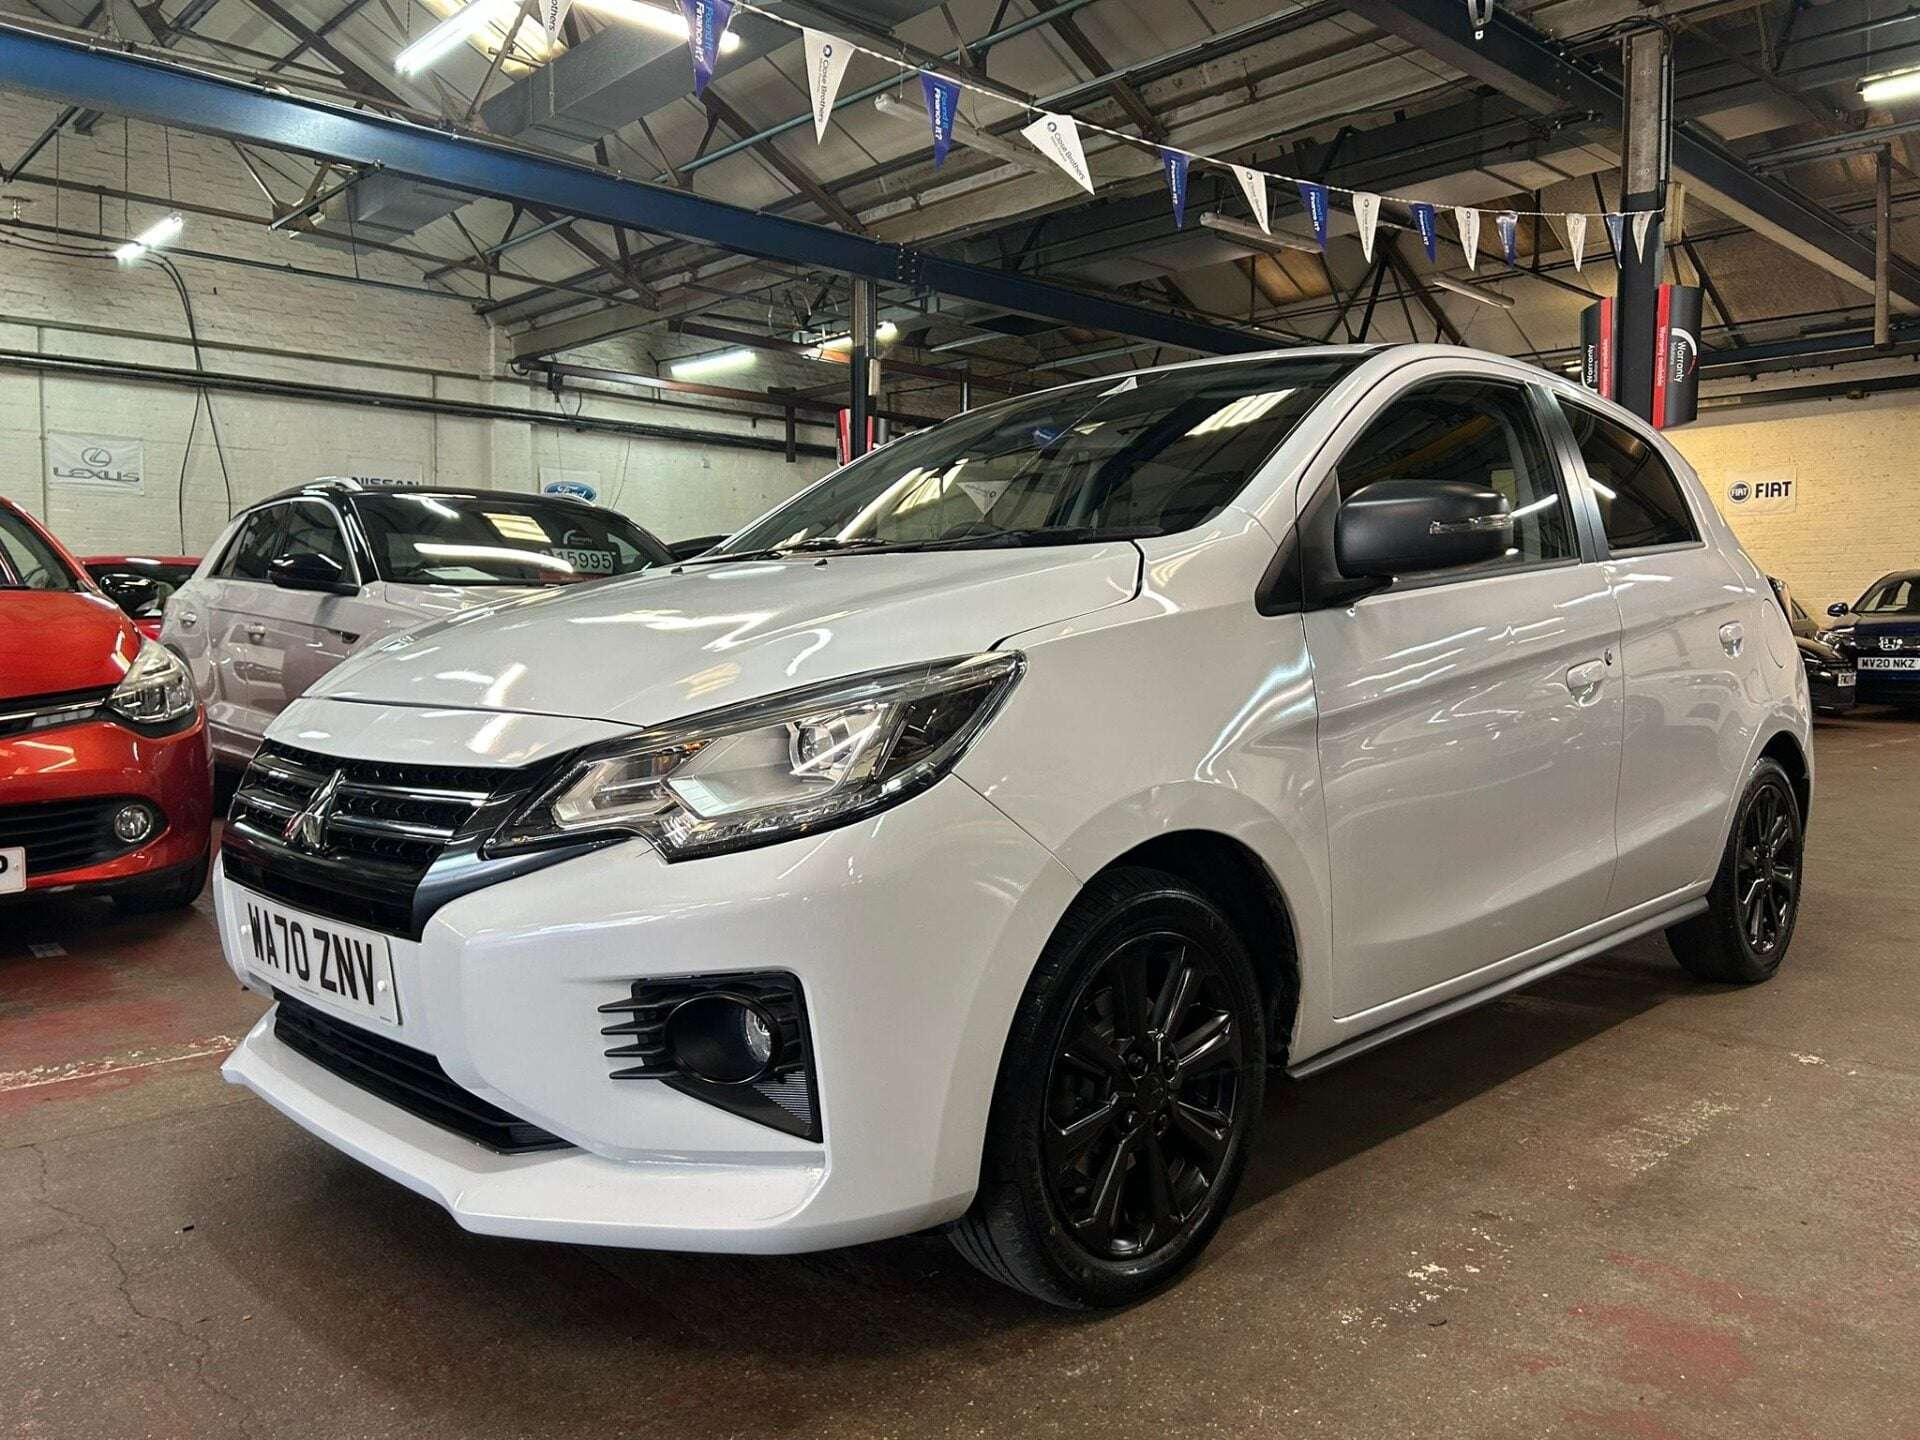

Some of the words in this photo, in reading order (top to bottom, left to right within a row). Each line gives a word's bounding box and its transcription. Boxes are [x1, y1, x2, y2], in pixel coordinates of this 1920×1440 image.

[696, 1, 704, 45] Finance
[821, 59, 829, 83] Close
[817, 83, 827, 123] Brothers
[1054, 132, 1067, 153] Close
[1065, 151, 1086, 181] Brothers
[1587, 344, 1595, 384] Warranty
[1674, 341, 1687, 383] Warranty
[53, 467, 140, 482] LEXUS
[1731, 487, 1748, 497] FIAT
[1755, 480, 1793, 499] FIAT
[1862, 658, 1890, 668] MV20
[1893, 658, 1916, 668] NKZ
[247, 902, 310, 982] WA70
[312, 927, 375, 1006] ZNV
